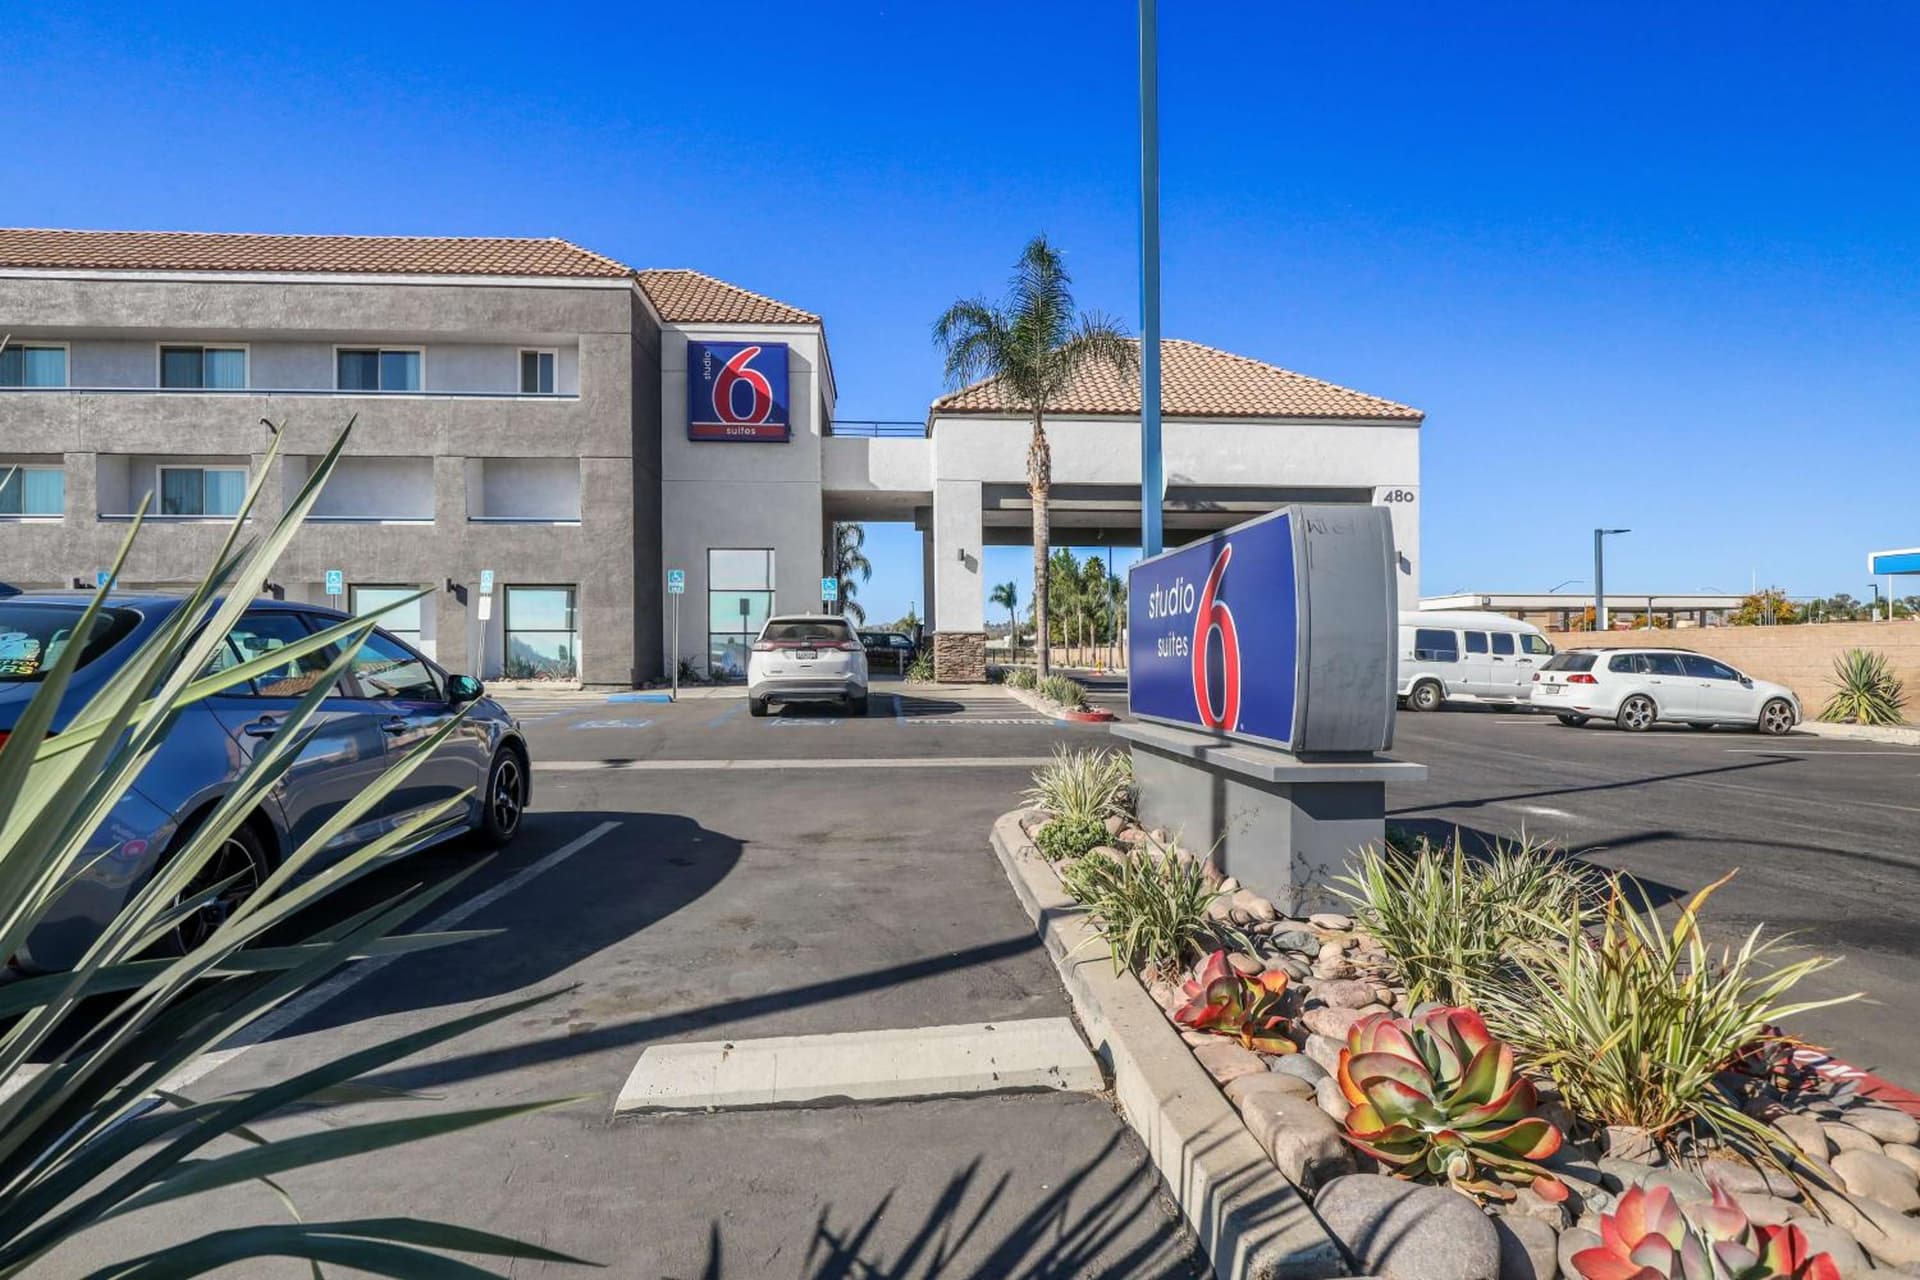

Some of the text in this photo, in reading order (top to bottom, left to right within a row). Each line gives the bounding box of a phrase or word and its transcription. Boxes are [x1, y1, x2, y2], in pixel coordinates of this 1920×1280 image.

[702, 351, 711, 380] studio
[712, 346, 773, 424] 6
[726, 425, 756, 435] suites
[1383, 489, 1415, 503] 480
[1149, 542, 1241, 733] studio 6
[1157, 631, 1189, 657] suites
